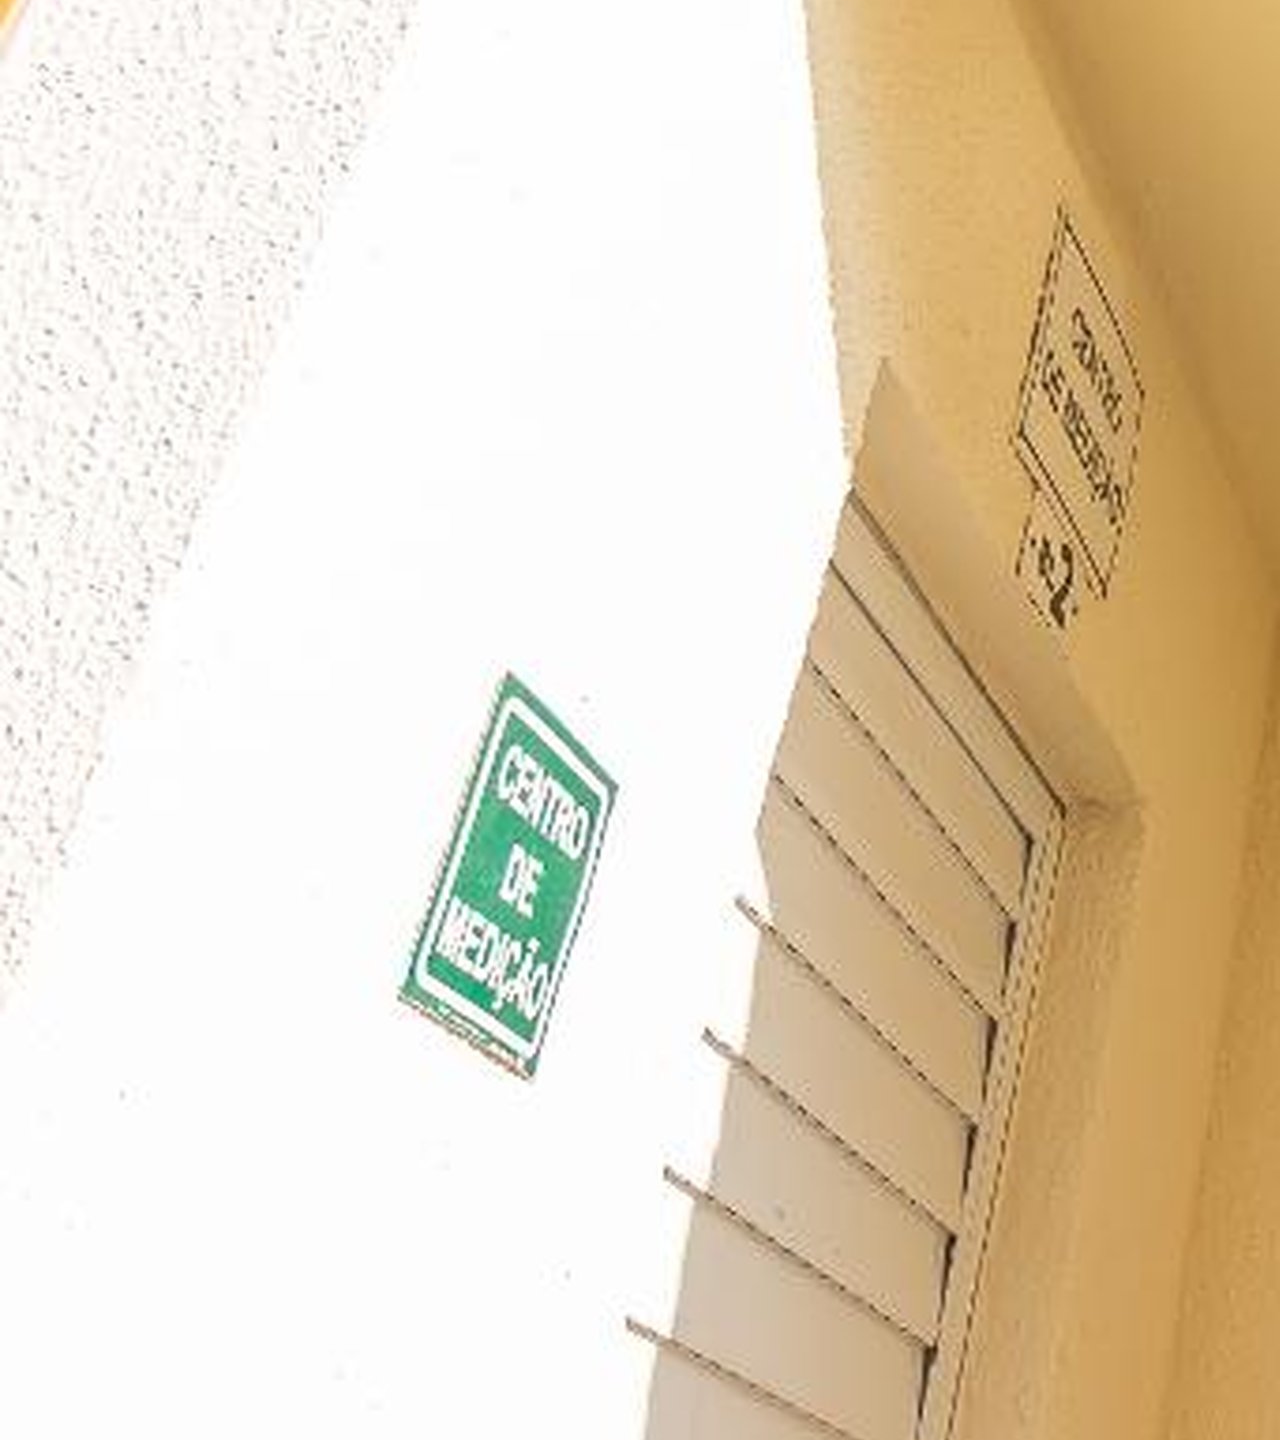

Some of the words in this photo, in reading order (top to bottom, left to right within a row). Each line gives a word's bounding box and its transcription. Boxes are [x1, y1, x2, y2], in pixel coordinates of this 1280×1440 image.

[497, 744, 591, 860] CENTRO
[500, 842, 545, 918] DE
[435, 894, 551, 1021] MEDIÇÃO
